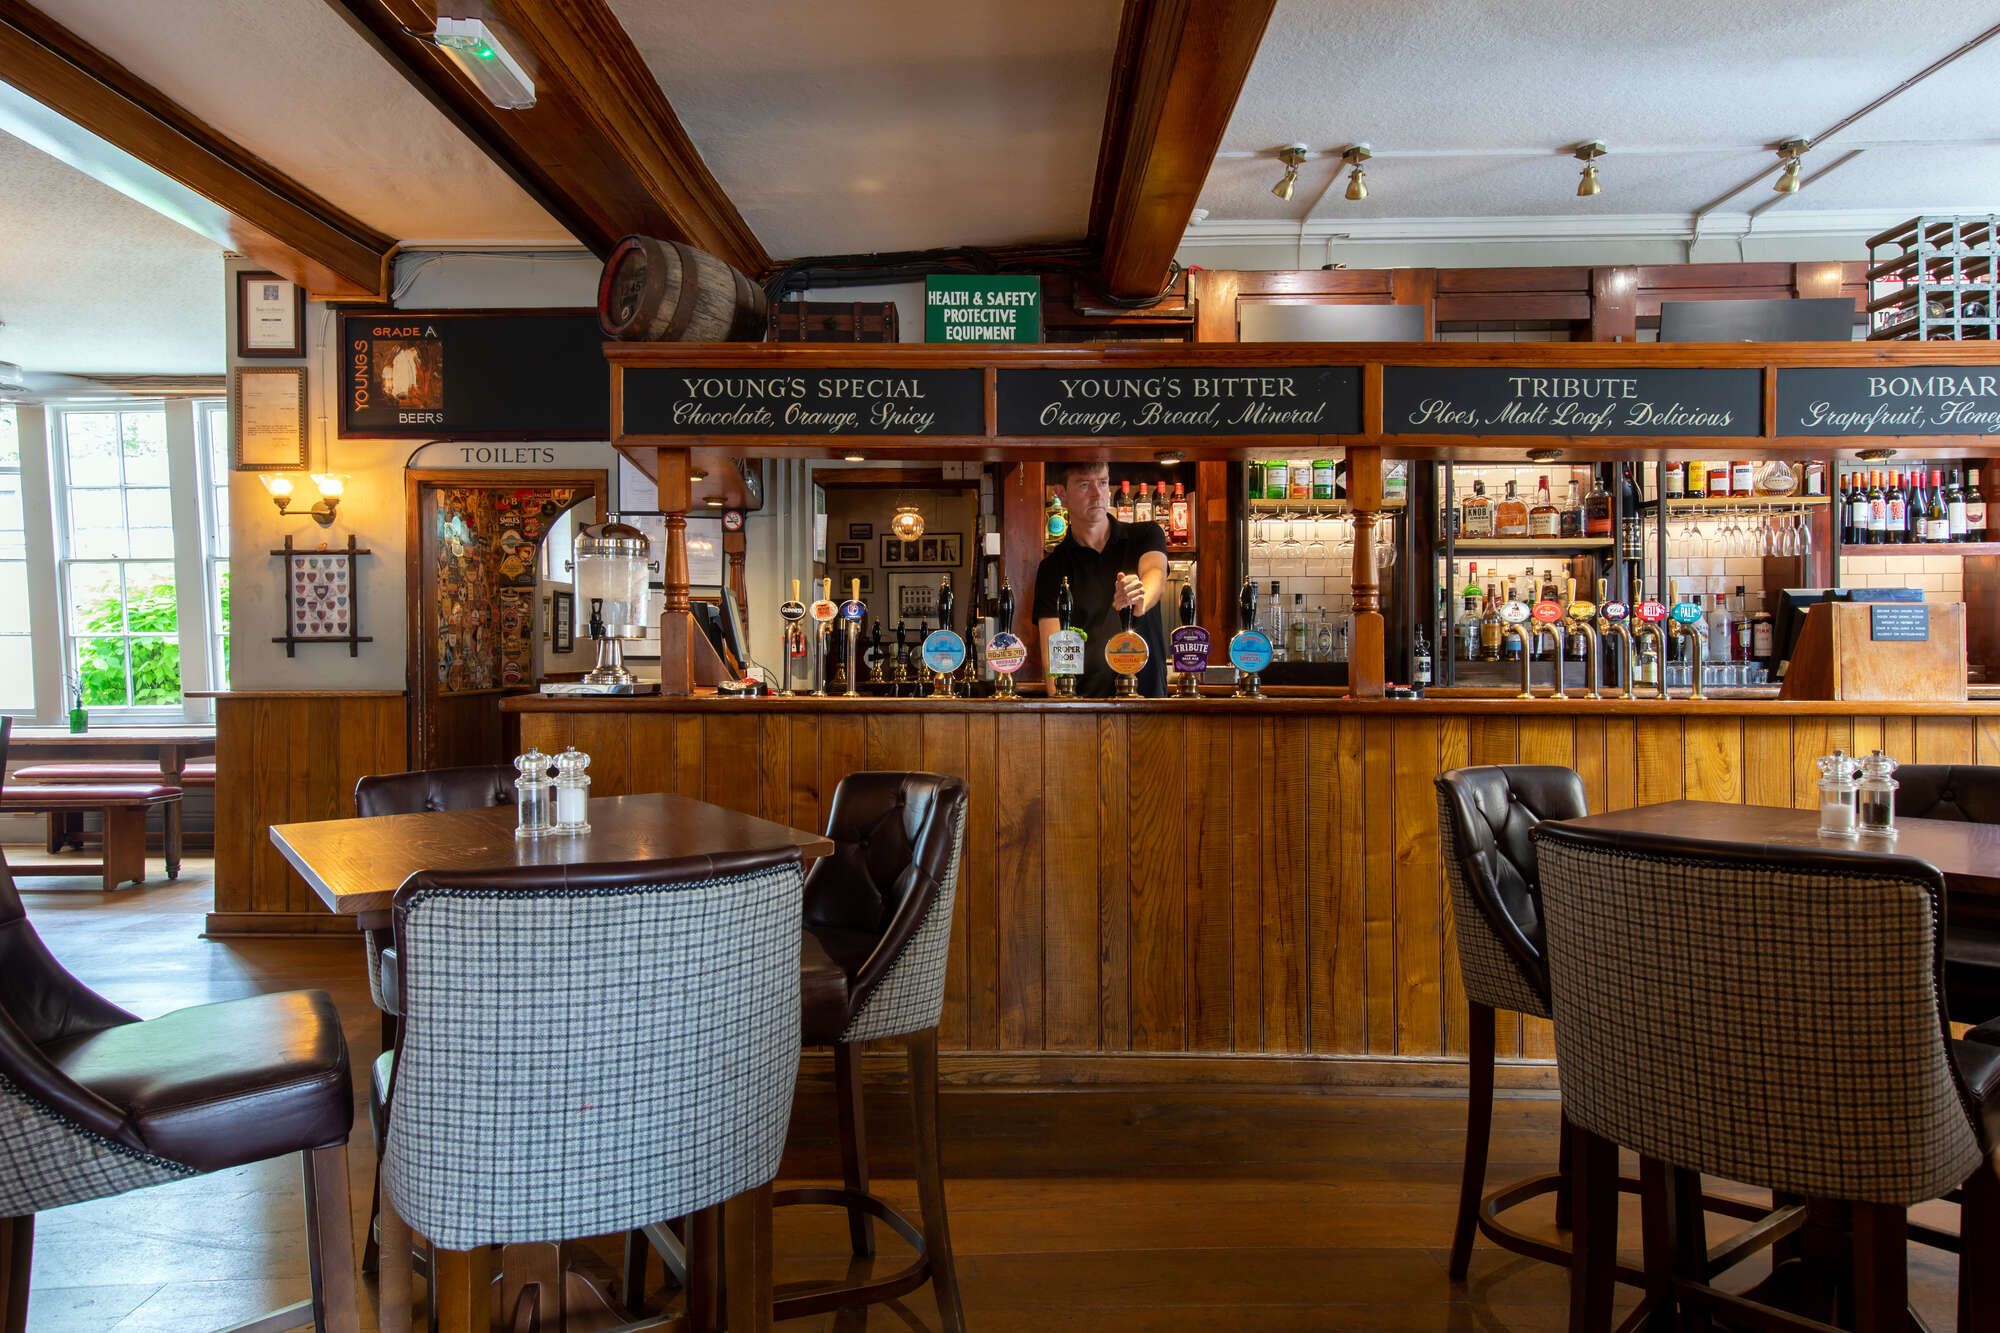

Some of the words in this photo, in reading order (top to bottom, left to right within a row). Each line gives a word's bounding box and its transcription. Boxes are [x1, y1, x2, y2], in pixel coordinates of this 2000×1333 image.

[928, 291, 969, 306] HEALTH
[973, 291, 983, 306] &
[987, 291, 1037, 306] SAFETY
[943, 309, 1017, 323] PROTECTIVE
[373, 327, 421, 338] GRADE
[424, 326, 437, 338] A
[946, 326, 1017, 341] EQUIPMENT
[354, 339, 369, 412] YOUNGS
[682, 376, 806, 398] YOUNG'S
[818, 378, 926, 399] SPECIAL
[1059, 376, 1182, 398] YOUNG'S
[1193, 377, 1297, 398] BITTER
[1508, 376, 1638, 399] TRIBUTE
[1867, 376, 1999, 398] BOMBAR
[399, 412, 444, 424] BEERS
[672, 400, 776, 428] Chocolate,
[784, 402, 860, 434] Orange,
[869, 402, 936, 434] Spicy
[1039, 401, 1127, 434] Orange,
[1132, 402, 1220, 428] Bread,
[1227, 401, 1327, 425] Mineral
[1408, 398, 1480, 428] Sloes,
[1485, 401, 1547, 426] Malt
[1550, 402, 1617, 432] Loaf,
[1623, 402, 1735, 426] Delicious
[1800, 400, 1926, 433] Grapefruit,
[460, 447, 555, 463] TOILETS
[1468, 507, 1487, 516] KNOB
[1053, 645, 1081, 654] PROPER
[1173, 643, 1209, 653] TRIBUTE
